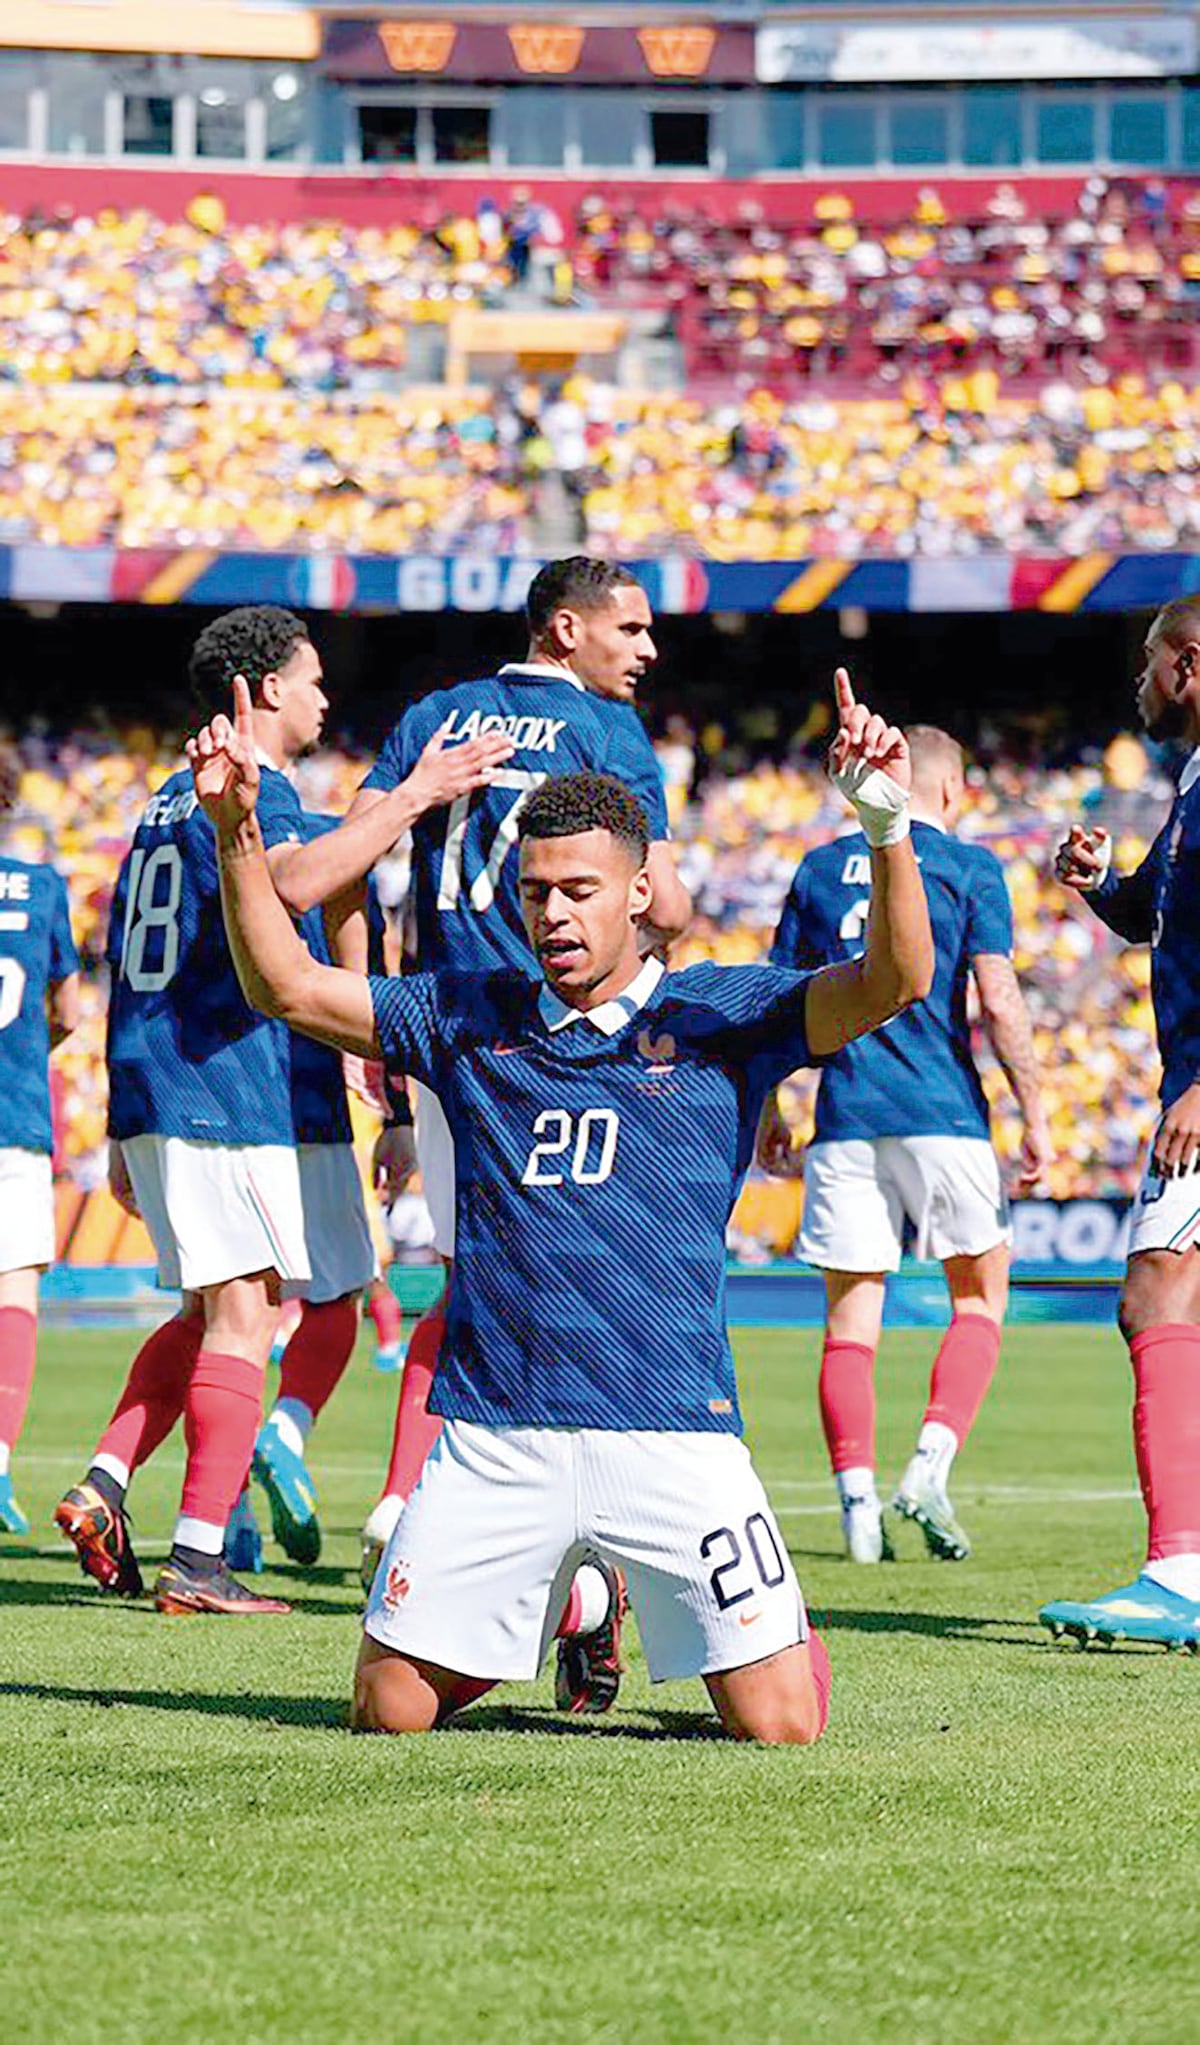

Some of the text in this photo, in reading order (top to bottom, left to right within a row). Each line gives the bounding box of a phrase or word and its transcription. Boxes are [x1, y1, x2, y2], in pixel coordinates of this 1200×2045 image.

[437, 766, 547, 912] 17
[119, 844, 183, 992] 18
[521, 1108, 619, 1186] 20
[1012, 1201, 1130, 1263] RO
[700, 1511, 785, 1612] 20
